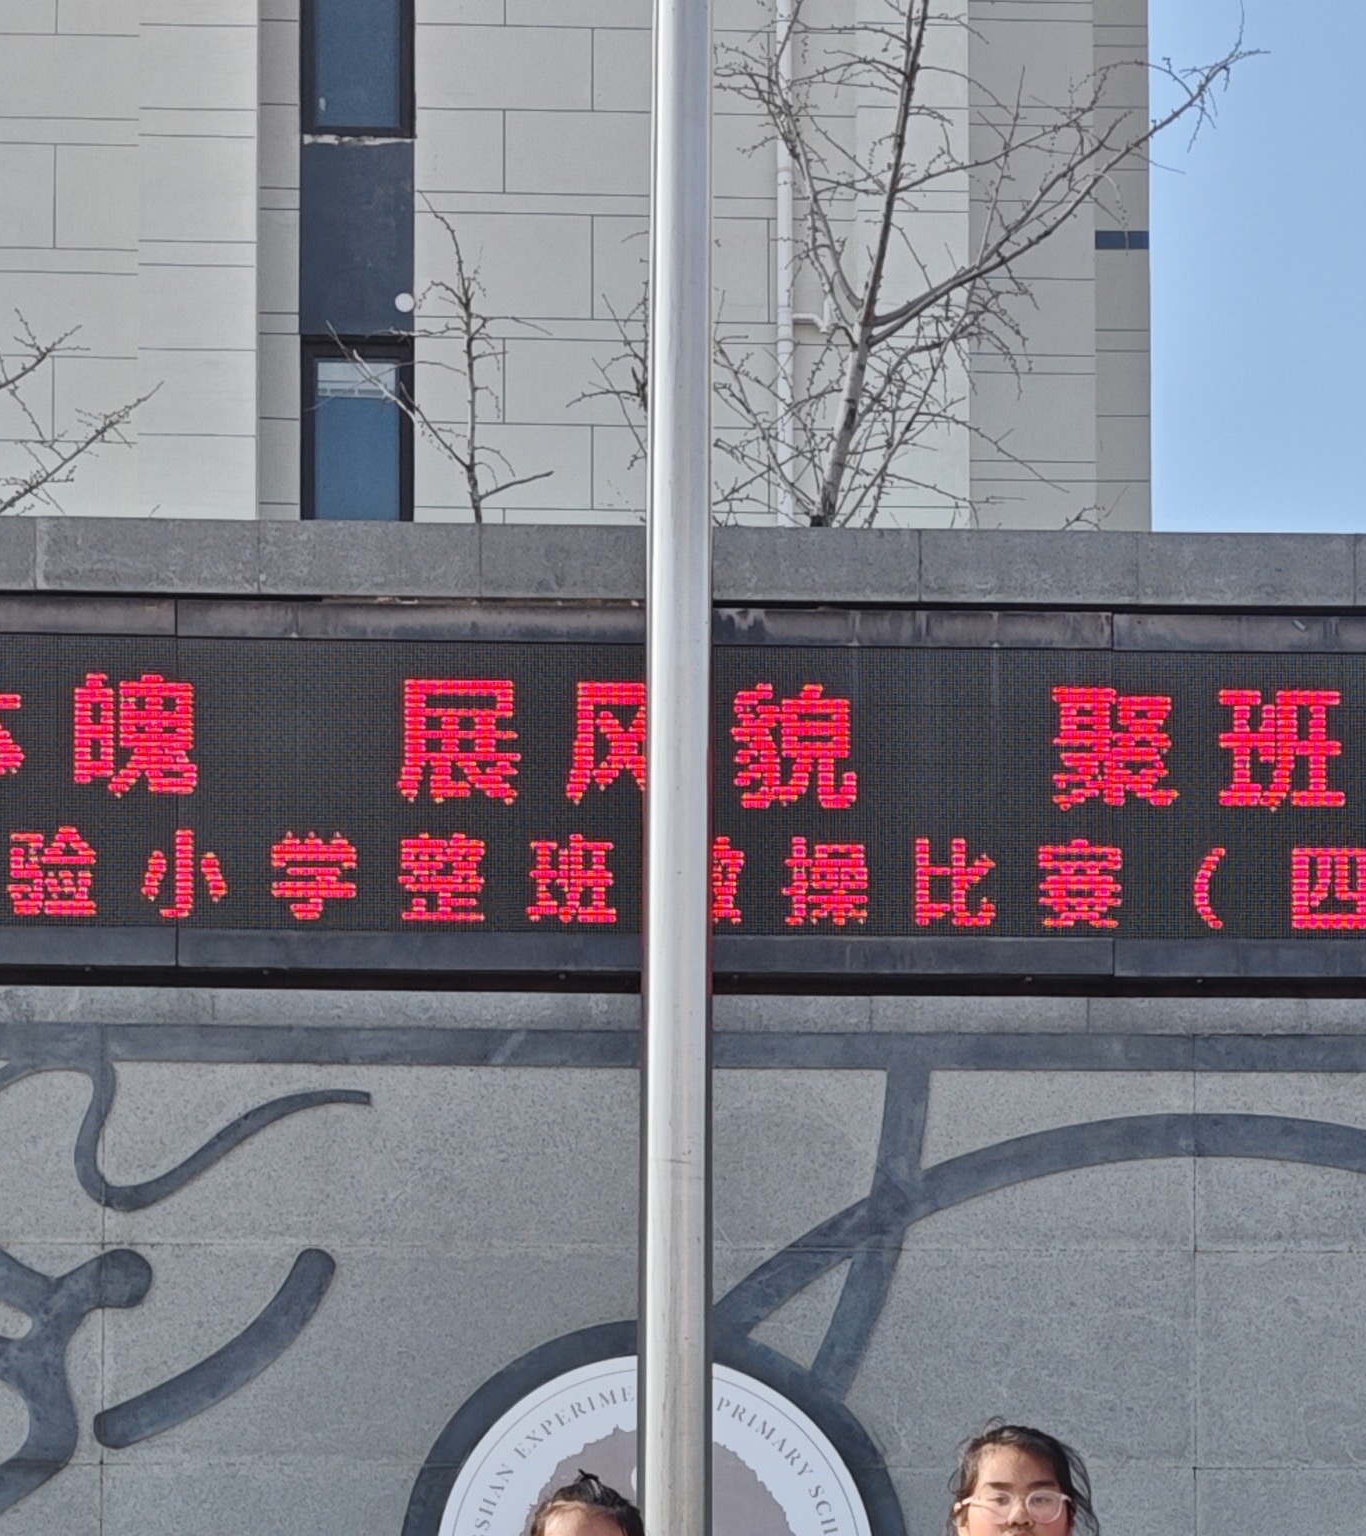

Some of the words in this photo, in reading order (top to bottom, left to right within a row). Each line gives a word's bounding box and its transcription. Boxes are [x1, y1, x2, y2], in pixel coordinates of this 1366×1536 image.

[395, 676, 859, 810] 展风貌
[513, 1385, 635, 1460] EXPERIME
[716, 1396, 814, 1478] PRIMARY
